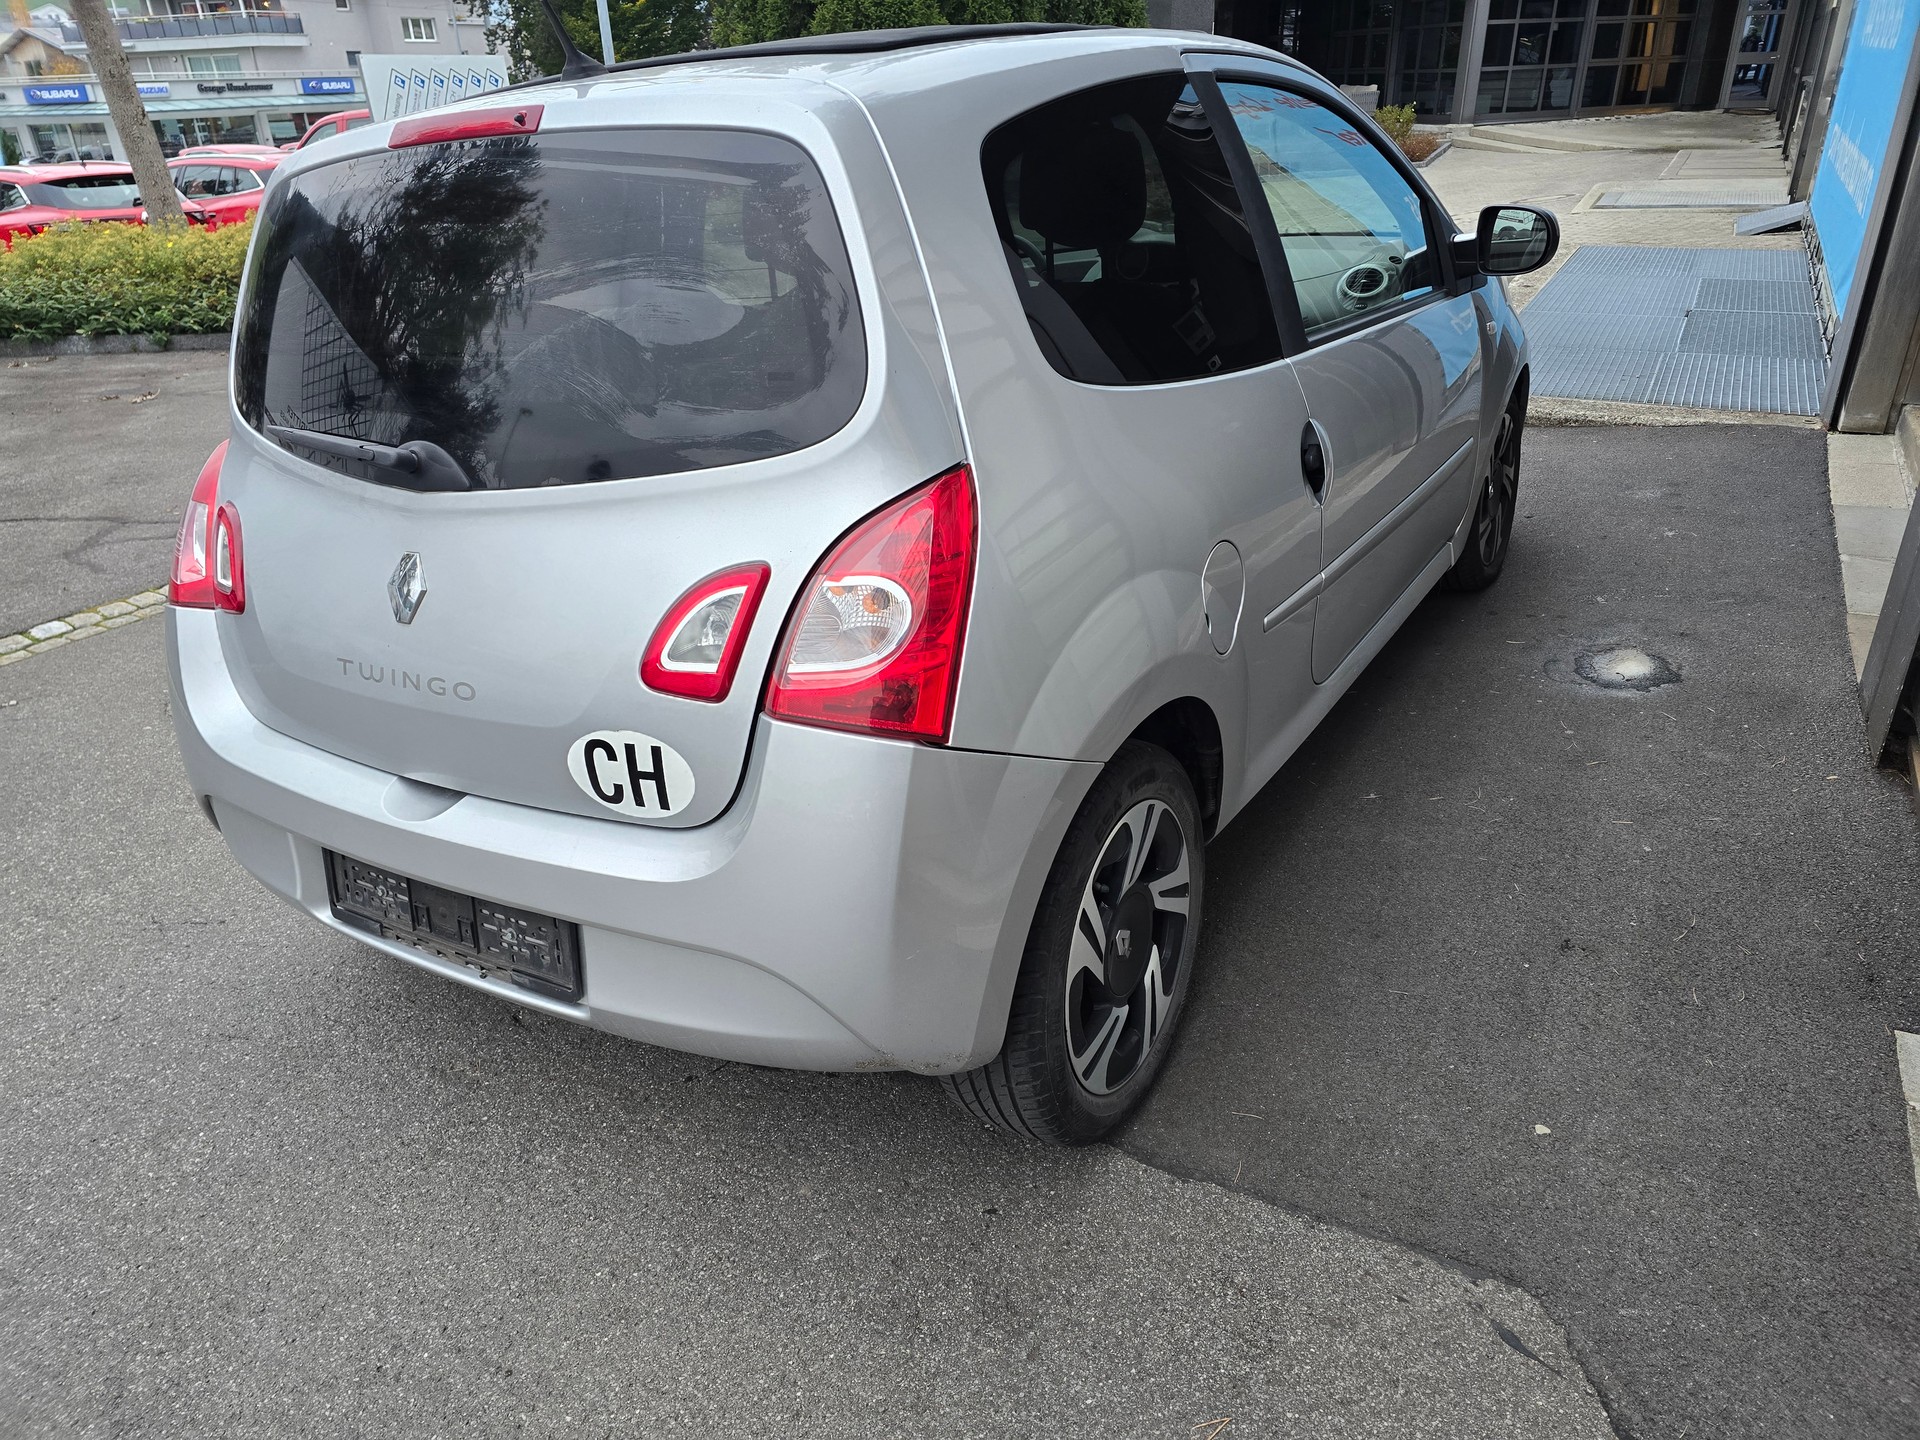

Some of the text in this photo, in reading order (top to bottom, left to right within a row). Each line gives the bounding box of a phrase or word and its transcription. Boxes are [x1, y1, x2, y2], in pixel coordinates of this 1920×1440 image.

[41, 89, 79, 99] SUBARU
[322, 81, 351, 90] SUBARU
[337, 657, 476, 701] TWINGO
[584, 738, 671, 811] CH
